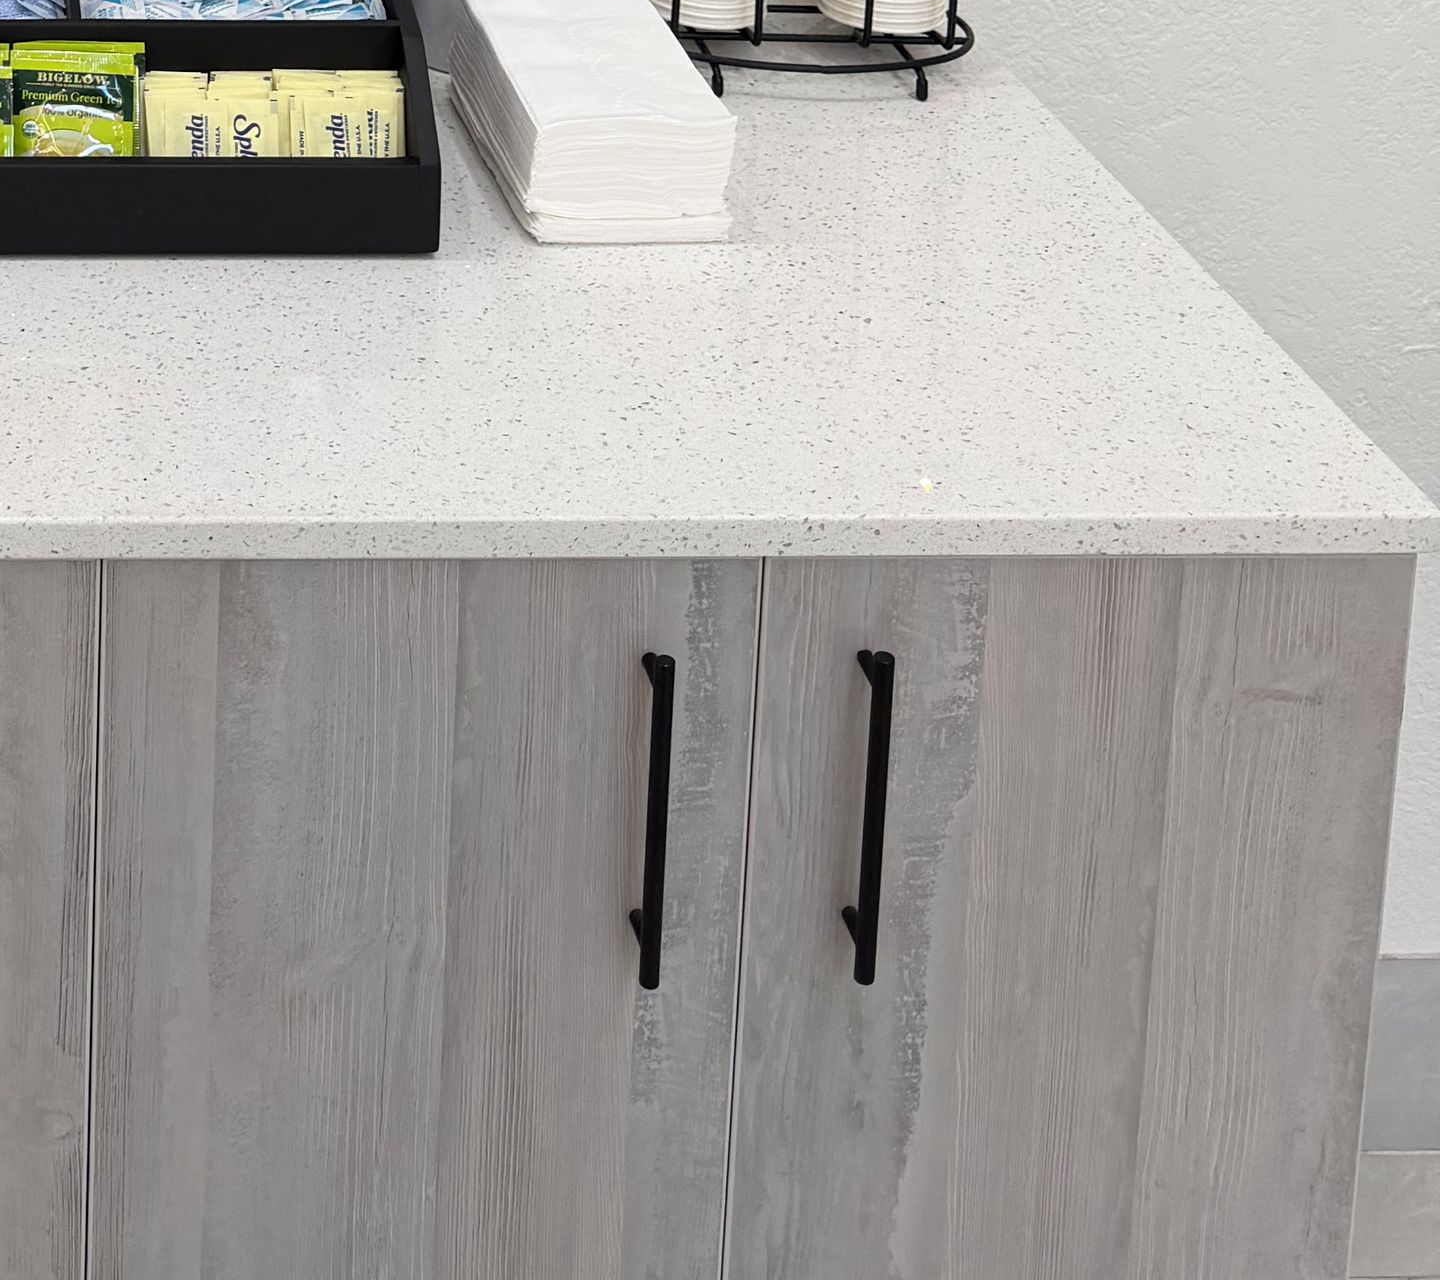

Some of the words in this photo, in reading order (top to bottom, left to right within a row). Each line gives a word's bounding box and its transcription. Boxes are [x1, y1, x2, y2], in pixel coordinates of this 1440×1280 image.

[37, 72, 109, 84] BIGELOW
[21, 89, 69, 101] Premium
[70, 91, 103, 104] Green
